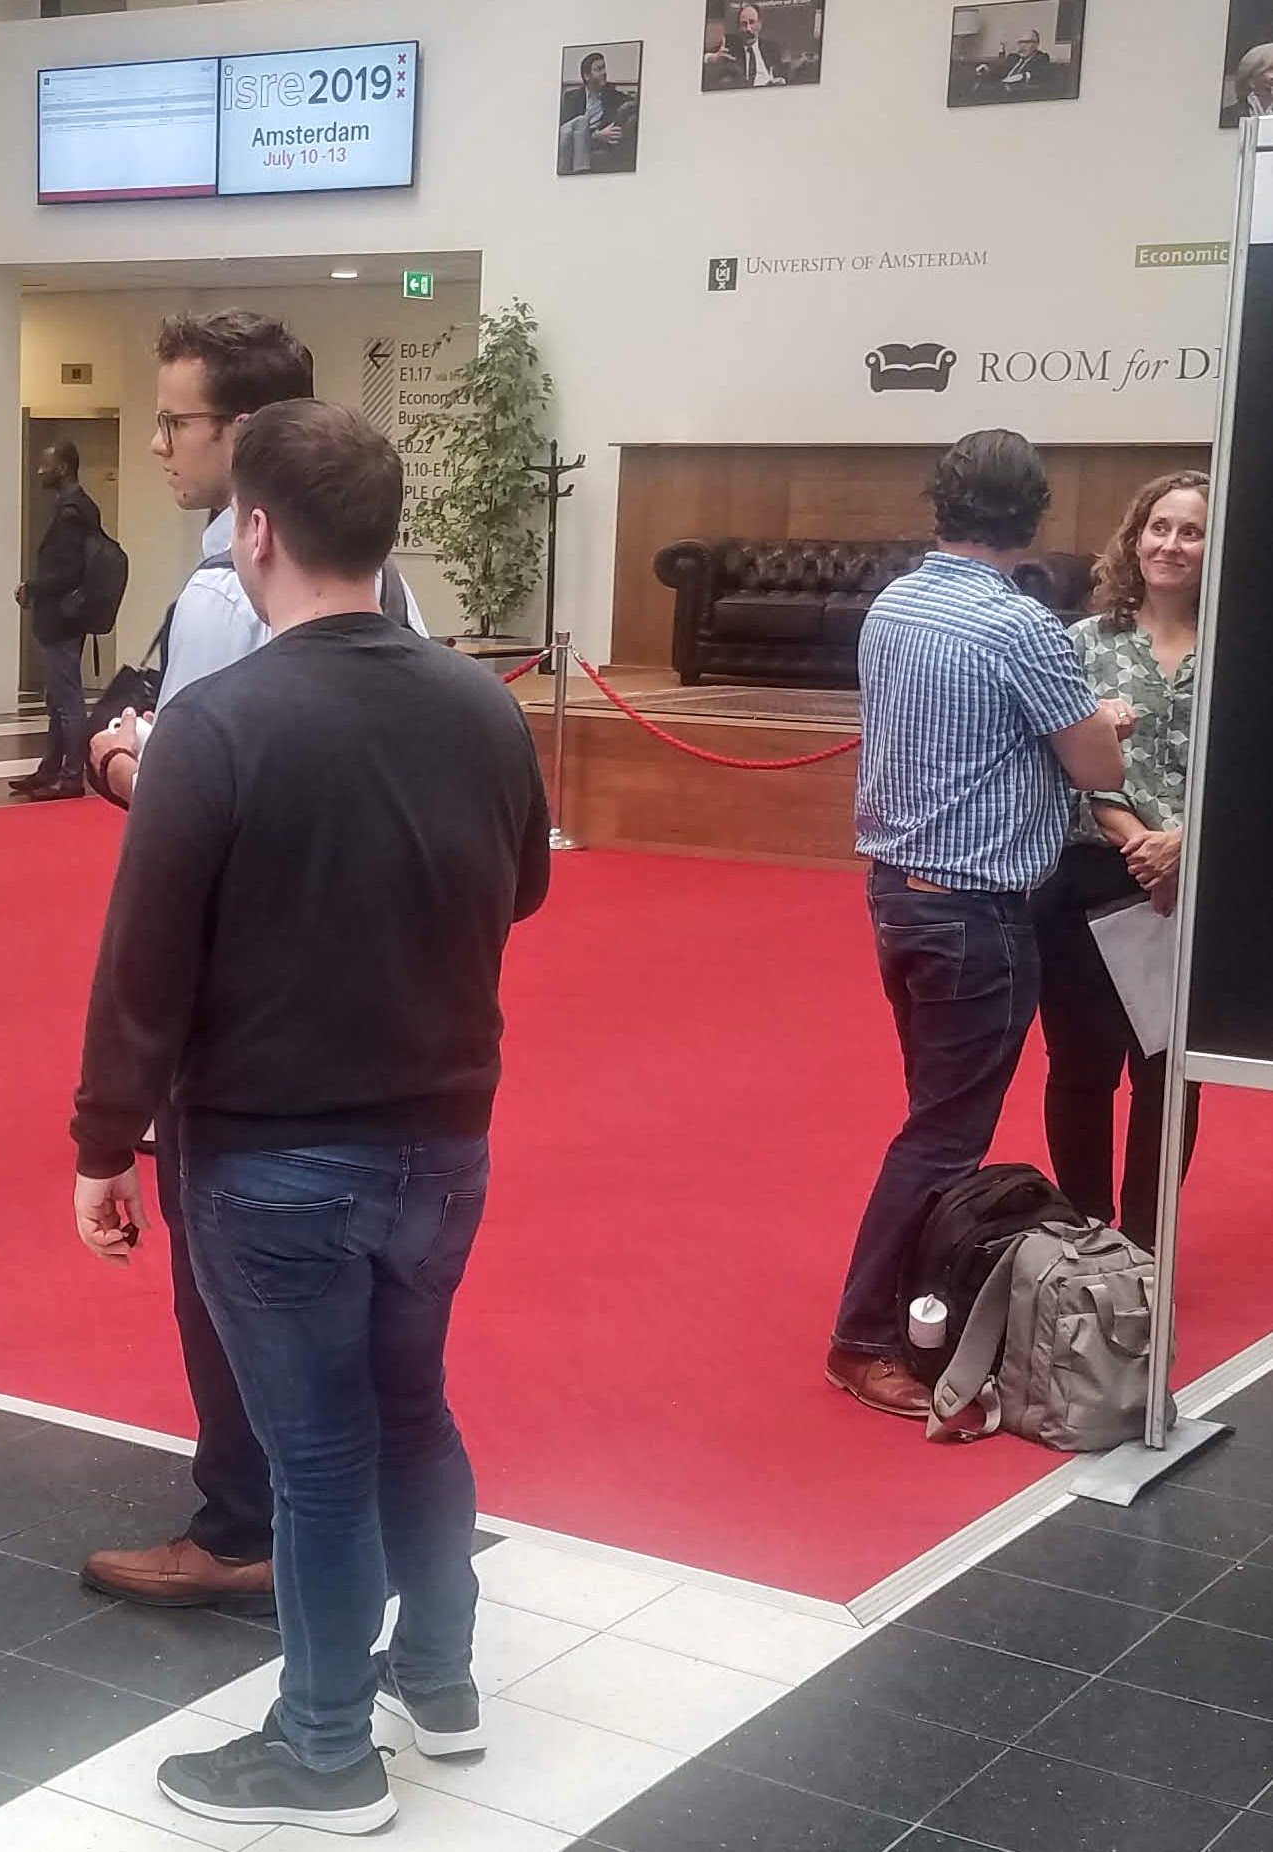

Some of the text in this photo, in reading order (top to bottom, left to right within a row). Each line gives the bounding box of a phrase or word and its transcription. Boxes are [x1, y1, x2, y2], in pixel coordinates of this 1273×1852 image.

[251, 122, 370, 148] Amsterdam
[263, 151, 296, 169] July
[745, 250, 988, 274] UNIVERSITY OF AMSTERDAM
[400, 343, 438, 359] E0-E7
[399, 367, 432, 382] E1.17
[977, 350, 1111, 383] ROOM
[1112, 349, 1169, 393] for
[404, 485, 427, 500] PLE
